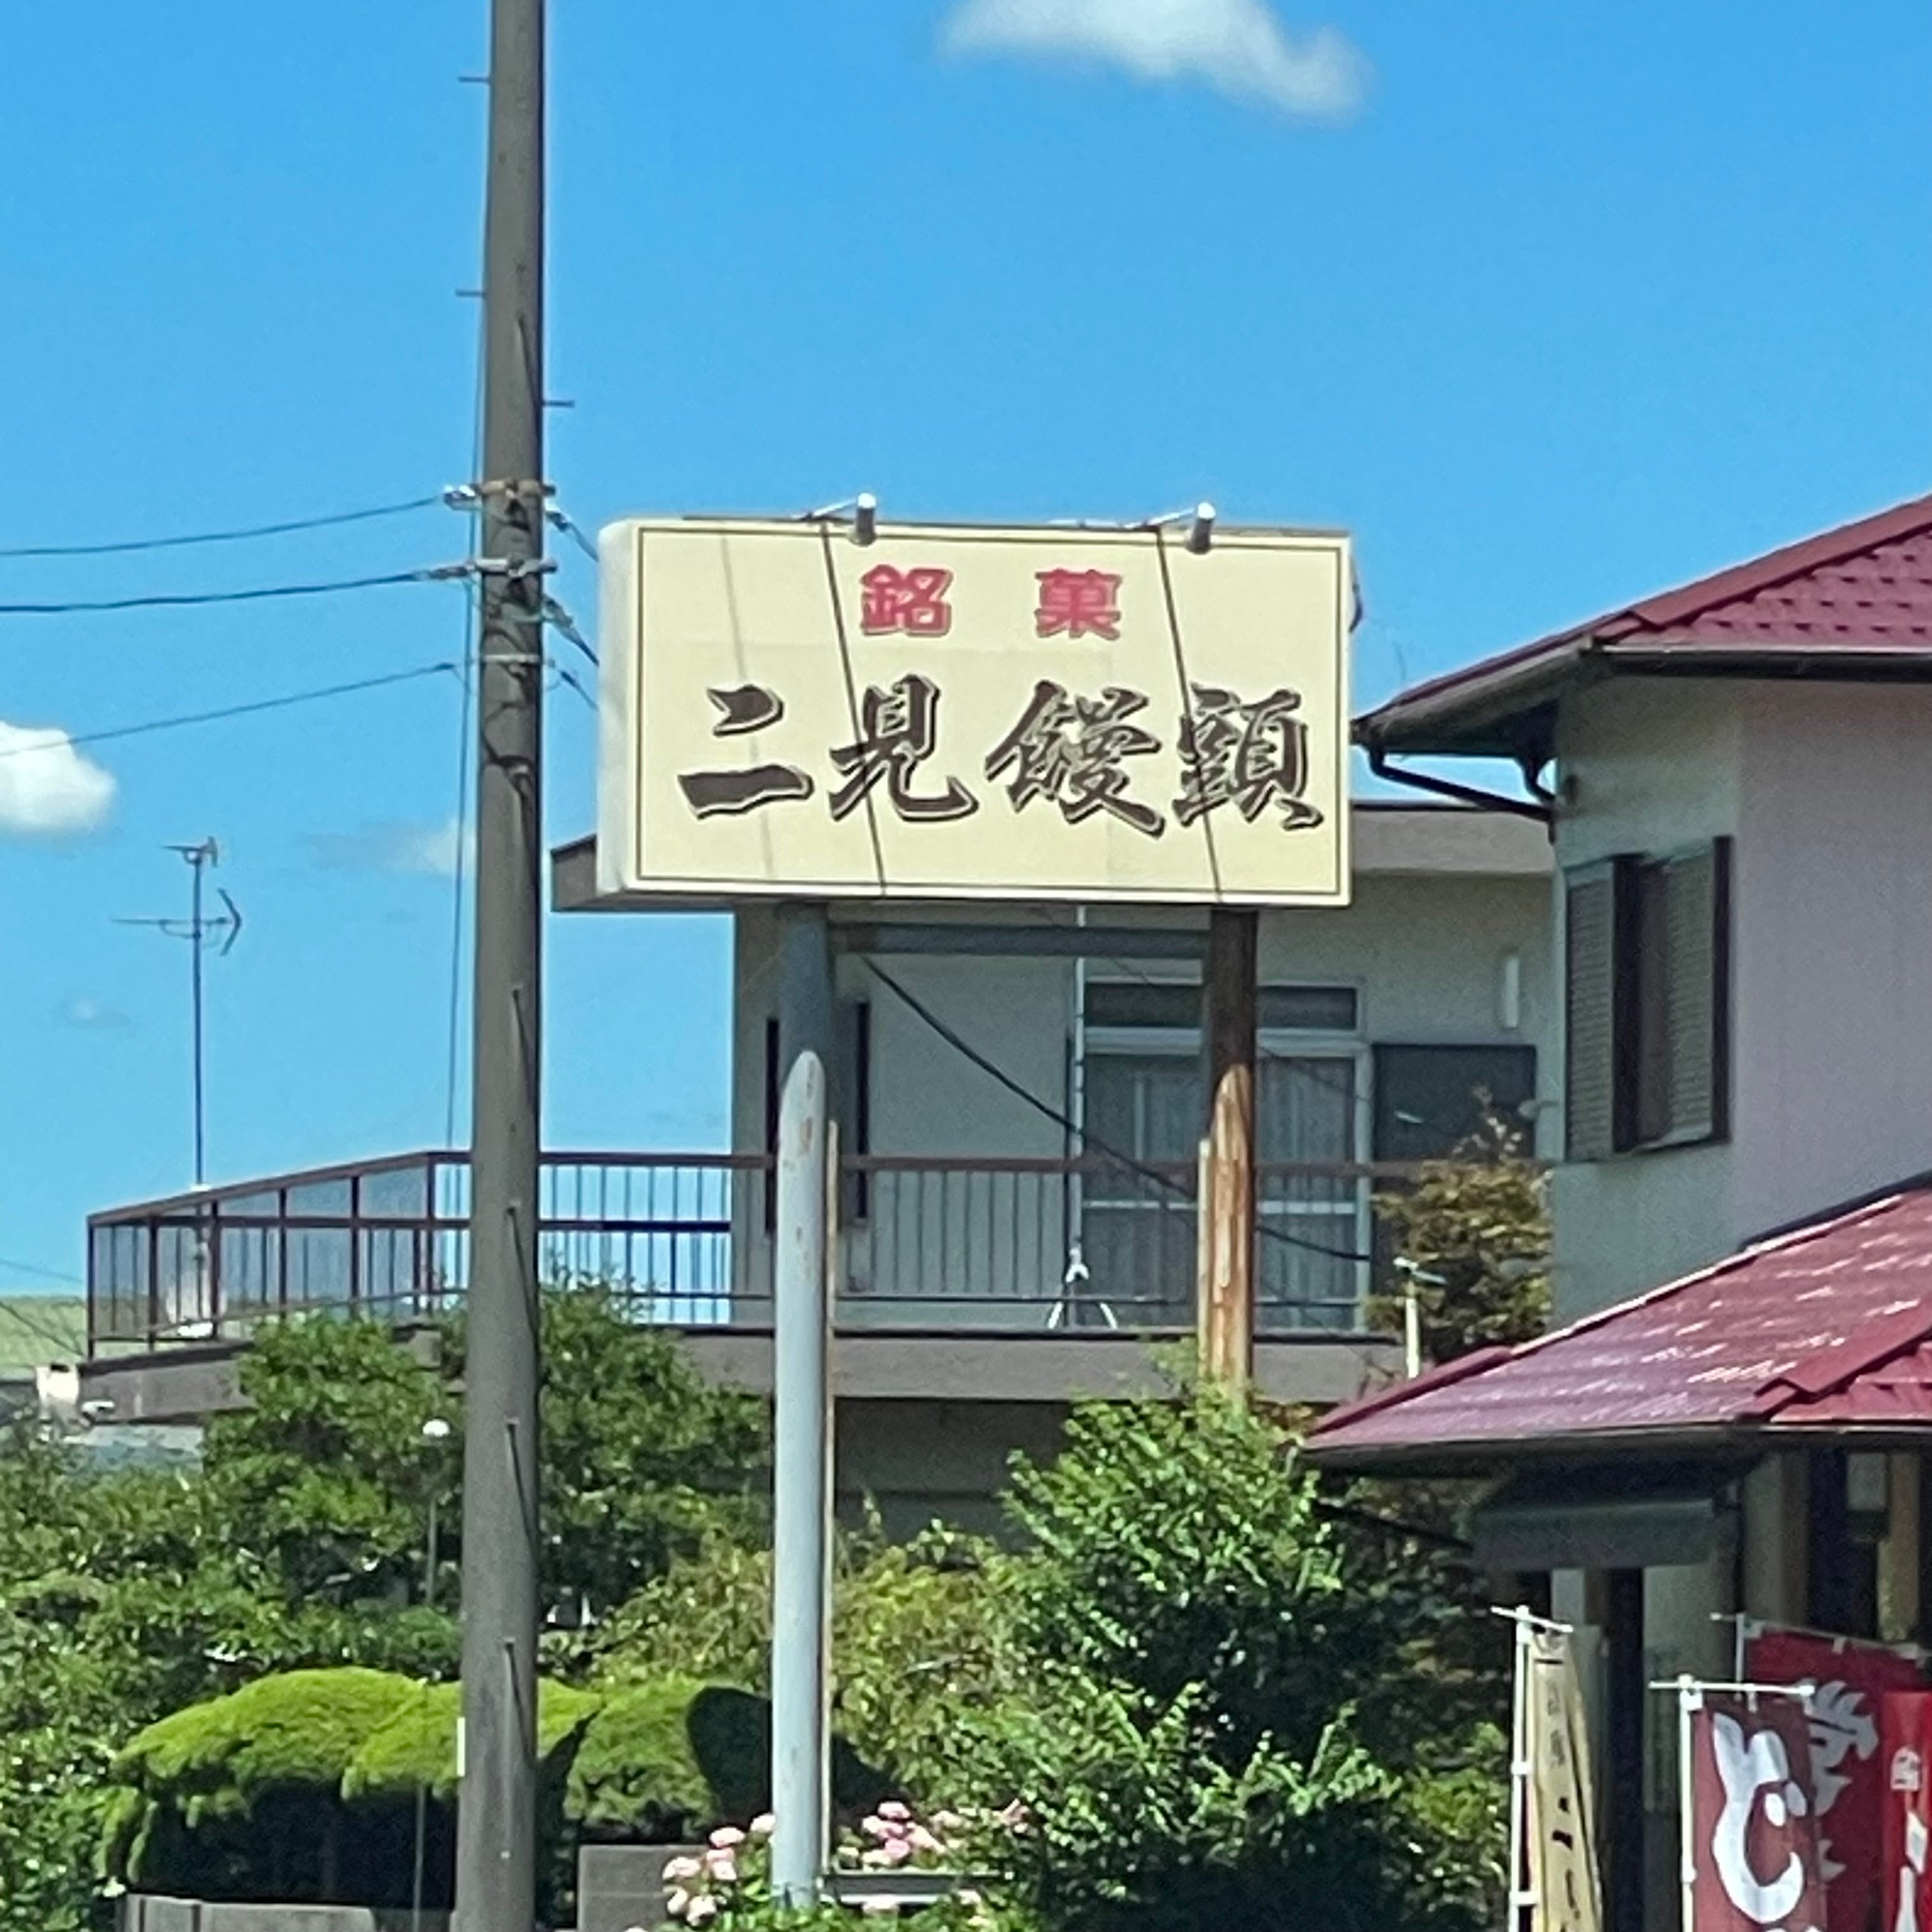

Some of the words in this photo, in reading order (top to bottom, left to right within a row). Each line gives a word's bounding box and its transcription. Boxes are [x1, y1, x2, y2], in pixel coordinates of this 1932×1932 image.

[861, 564, 1123, 640] 銘菓
[677, 674, 1324, 838] 二見饅頭
[1712, 1712, 1809, 1932] ど
